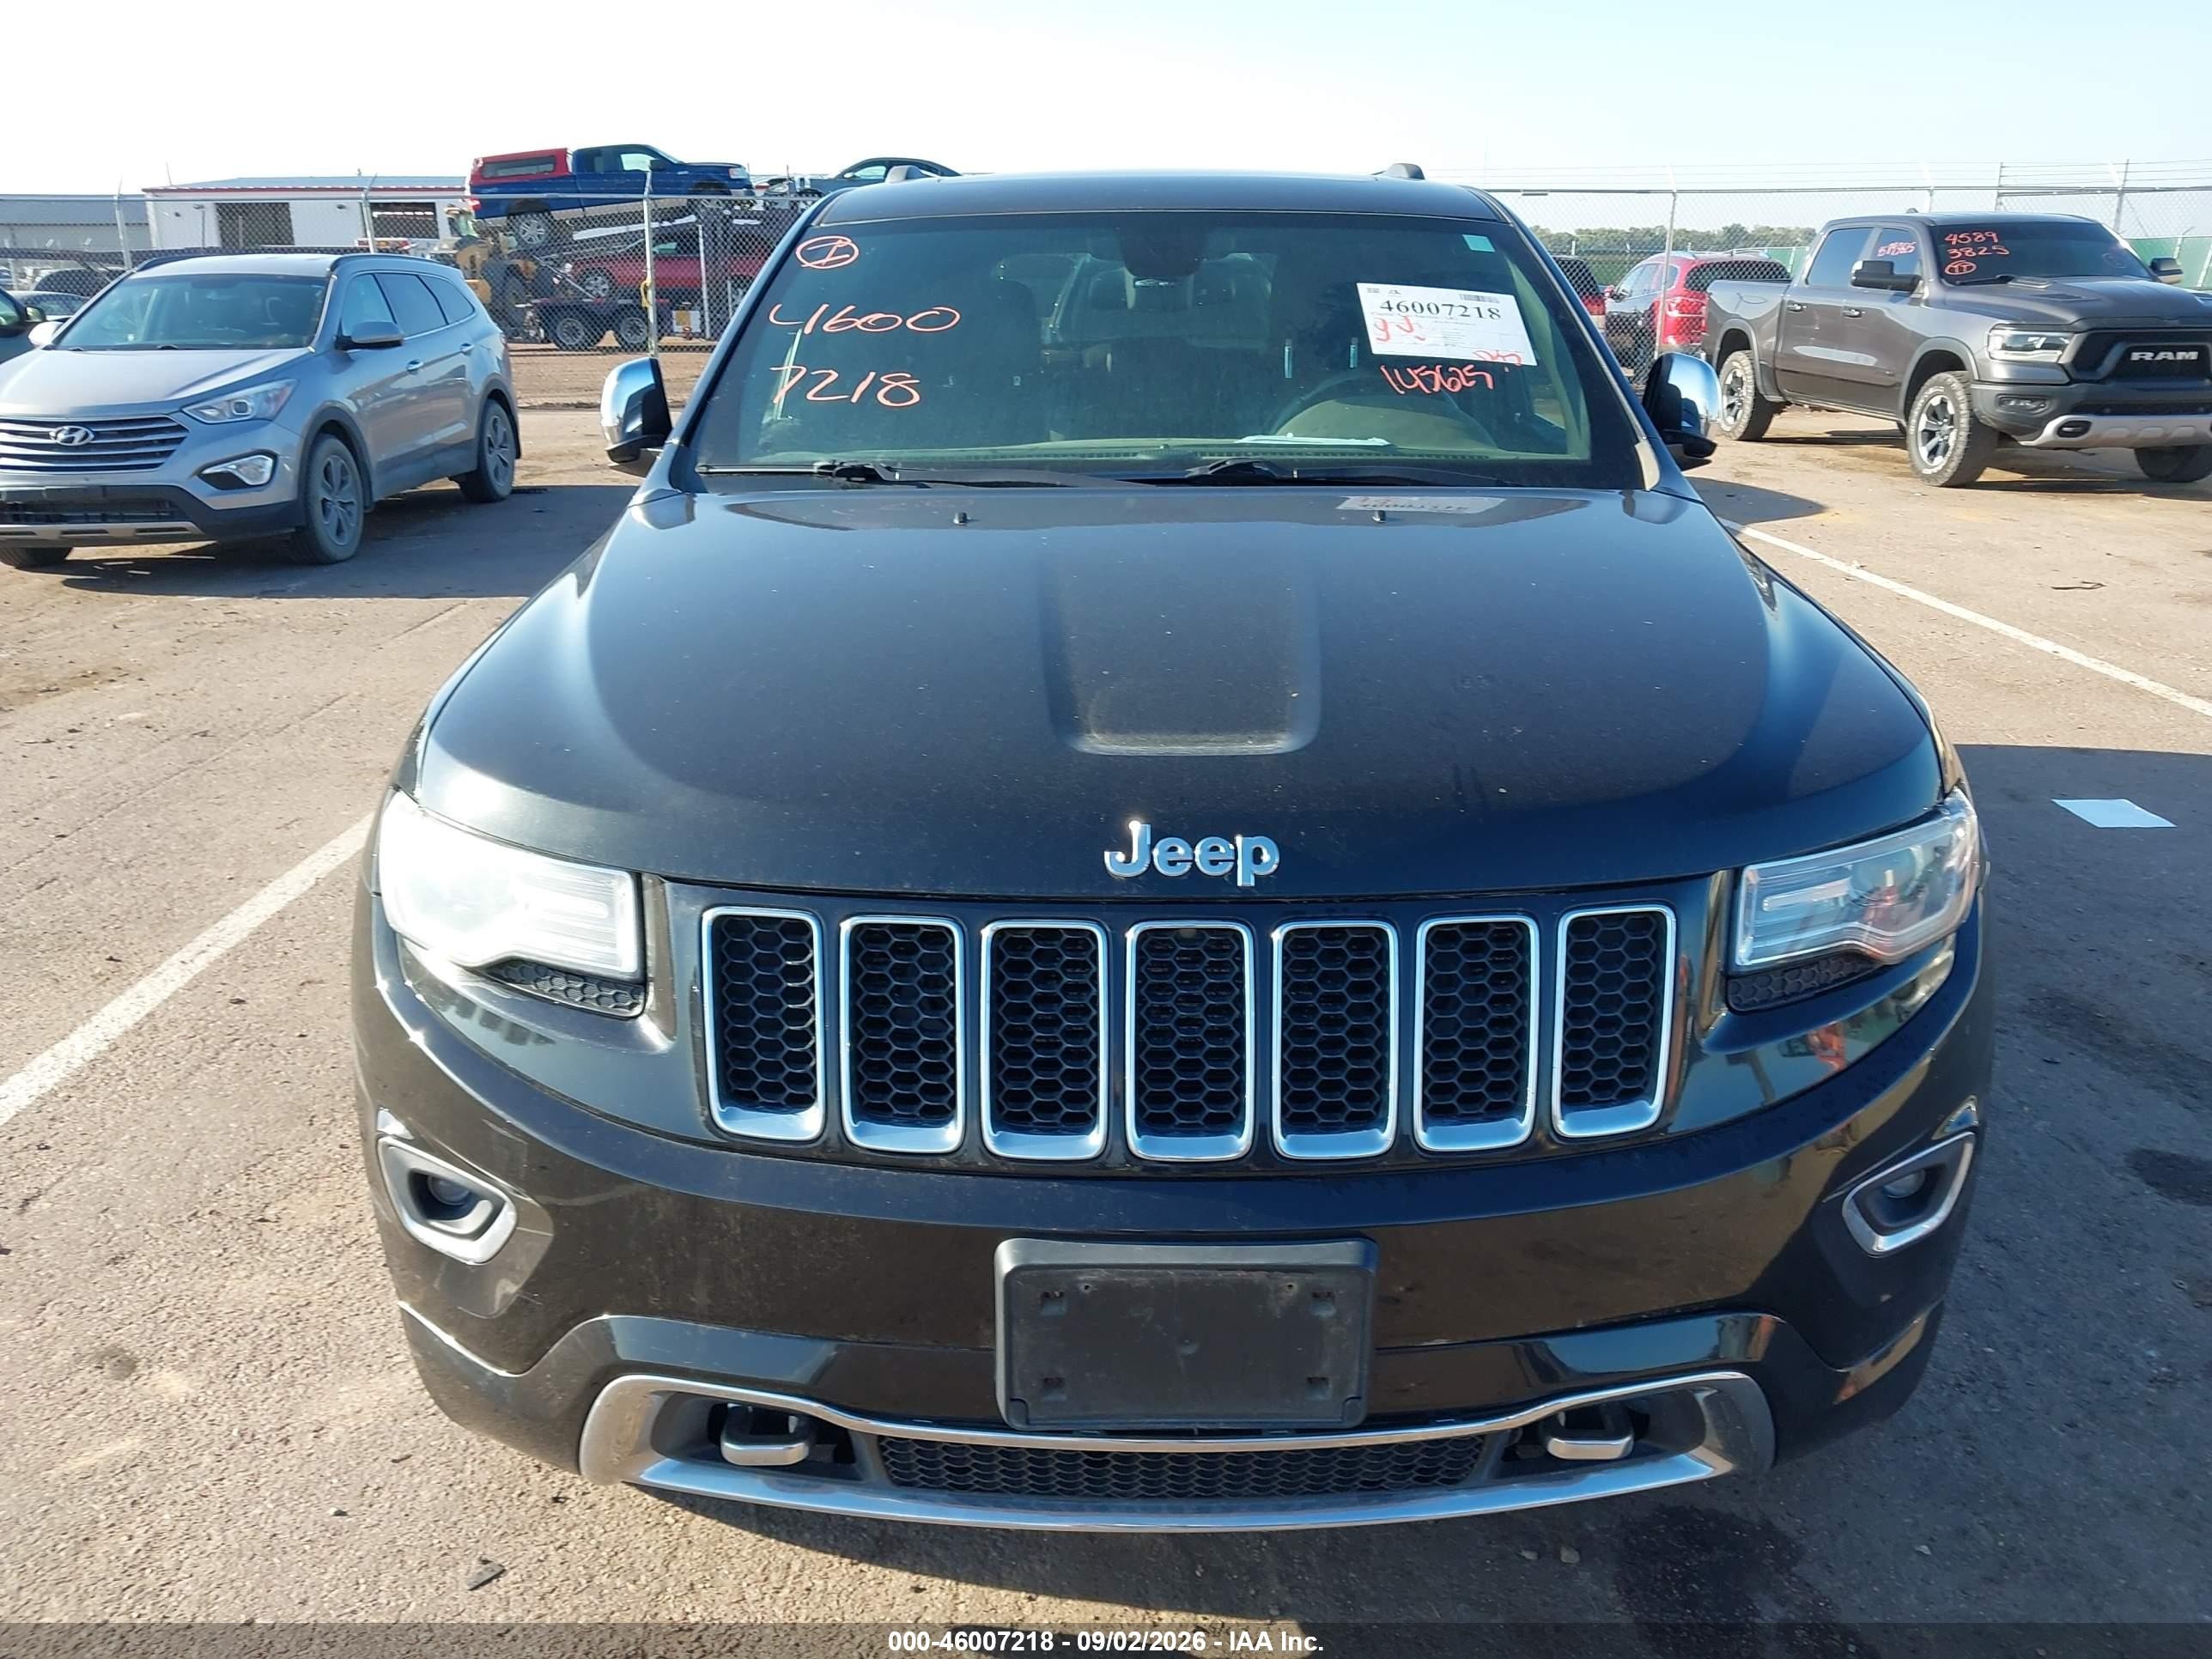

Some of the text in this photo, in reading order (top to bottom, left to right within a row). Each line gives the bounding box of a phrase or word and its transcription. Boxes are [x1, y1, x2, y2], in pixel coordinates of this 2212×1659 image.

[1944, 231, 1998, 246] 4589
[1946, 245, 2010, 259] 3825
[769, 303, 961, 335] 4600
[1380, 300, 1502, 320] 46007218
[2130, 351, 2199, 361] RAM
[769, 365, 921, 407] 7218
[1104, 819, 1280, 886] Jeep
